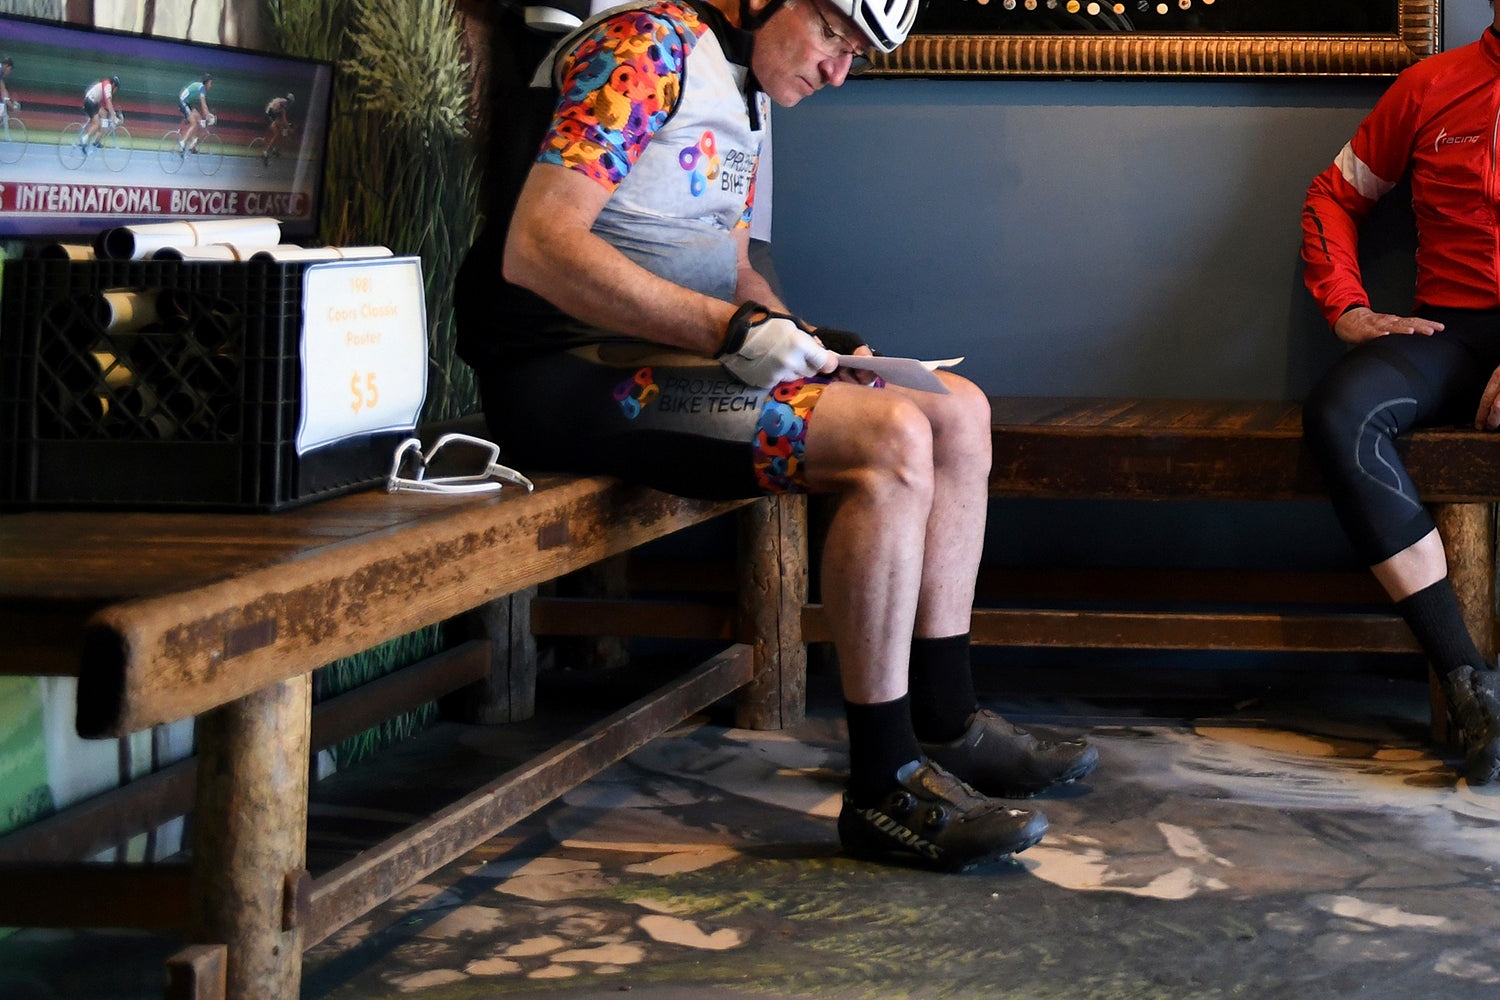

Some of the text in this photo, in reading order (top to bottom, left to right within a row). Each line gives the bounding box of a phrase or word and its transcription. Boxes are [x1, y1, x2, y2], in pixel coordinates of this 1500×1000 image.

[721, 171, 744, 195] BIKE
[16, 185, 161, 214] INTERNATIONAL
[170, 189, 238, 215] BICYCLE
[244, 191, 305, 216] CLASSIC
[327, 303, 399, 323] Coors Classic
[345, 330, 382, 346] Poster
[351, 370, 380, 416] $5
[664, 377, 749, 396] PROJECT
[659, 396, 758, 413] BIKE TECH
